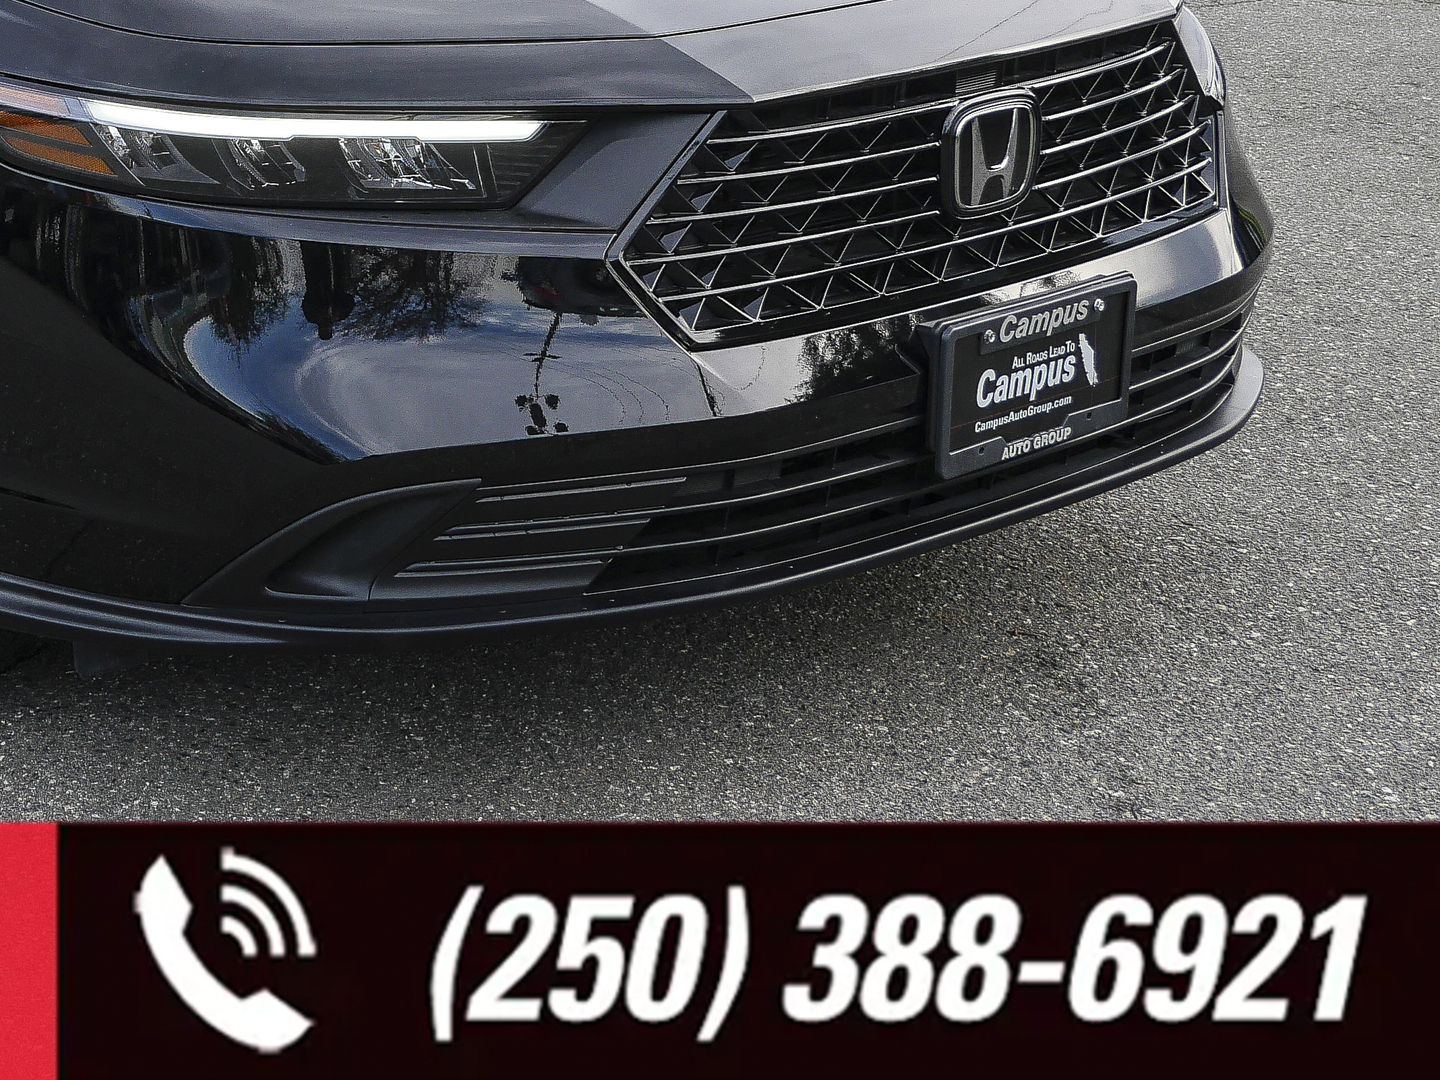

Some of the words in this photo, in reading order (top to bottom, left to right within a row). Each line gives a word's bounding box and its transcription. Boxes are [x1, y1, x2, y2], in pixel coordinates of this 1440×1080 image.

[999, 299, 1090, 343] Campus
[976, 355, 1077, 408] Campus
[974, 395, 1073, 433] CampusAutoGroup.com
[1001, 439, 1032, 461] AUTO
[1033, 426, 1073, 450] GROUP
